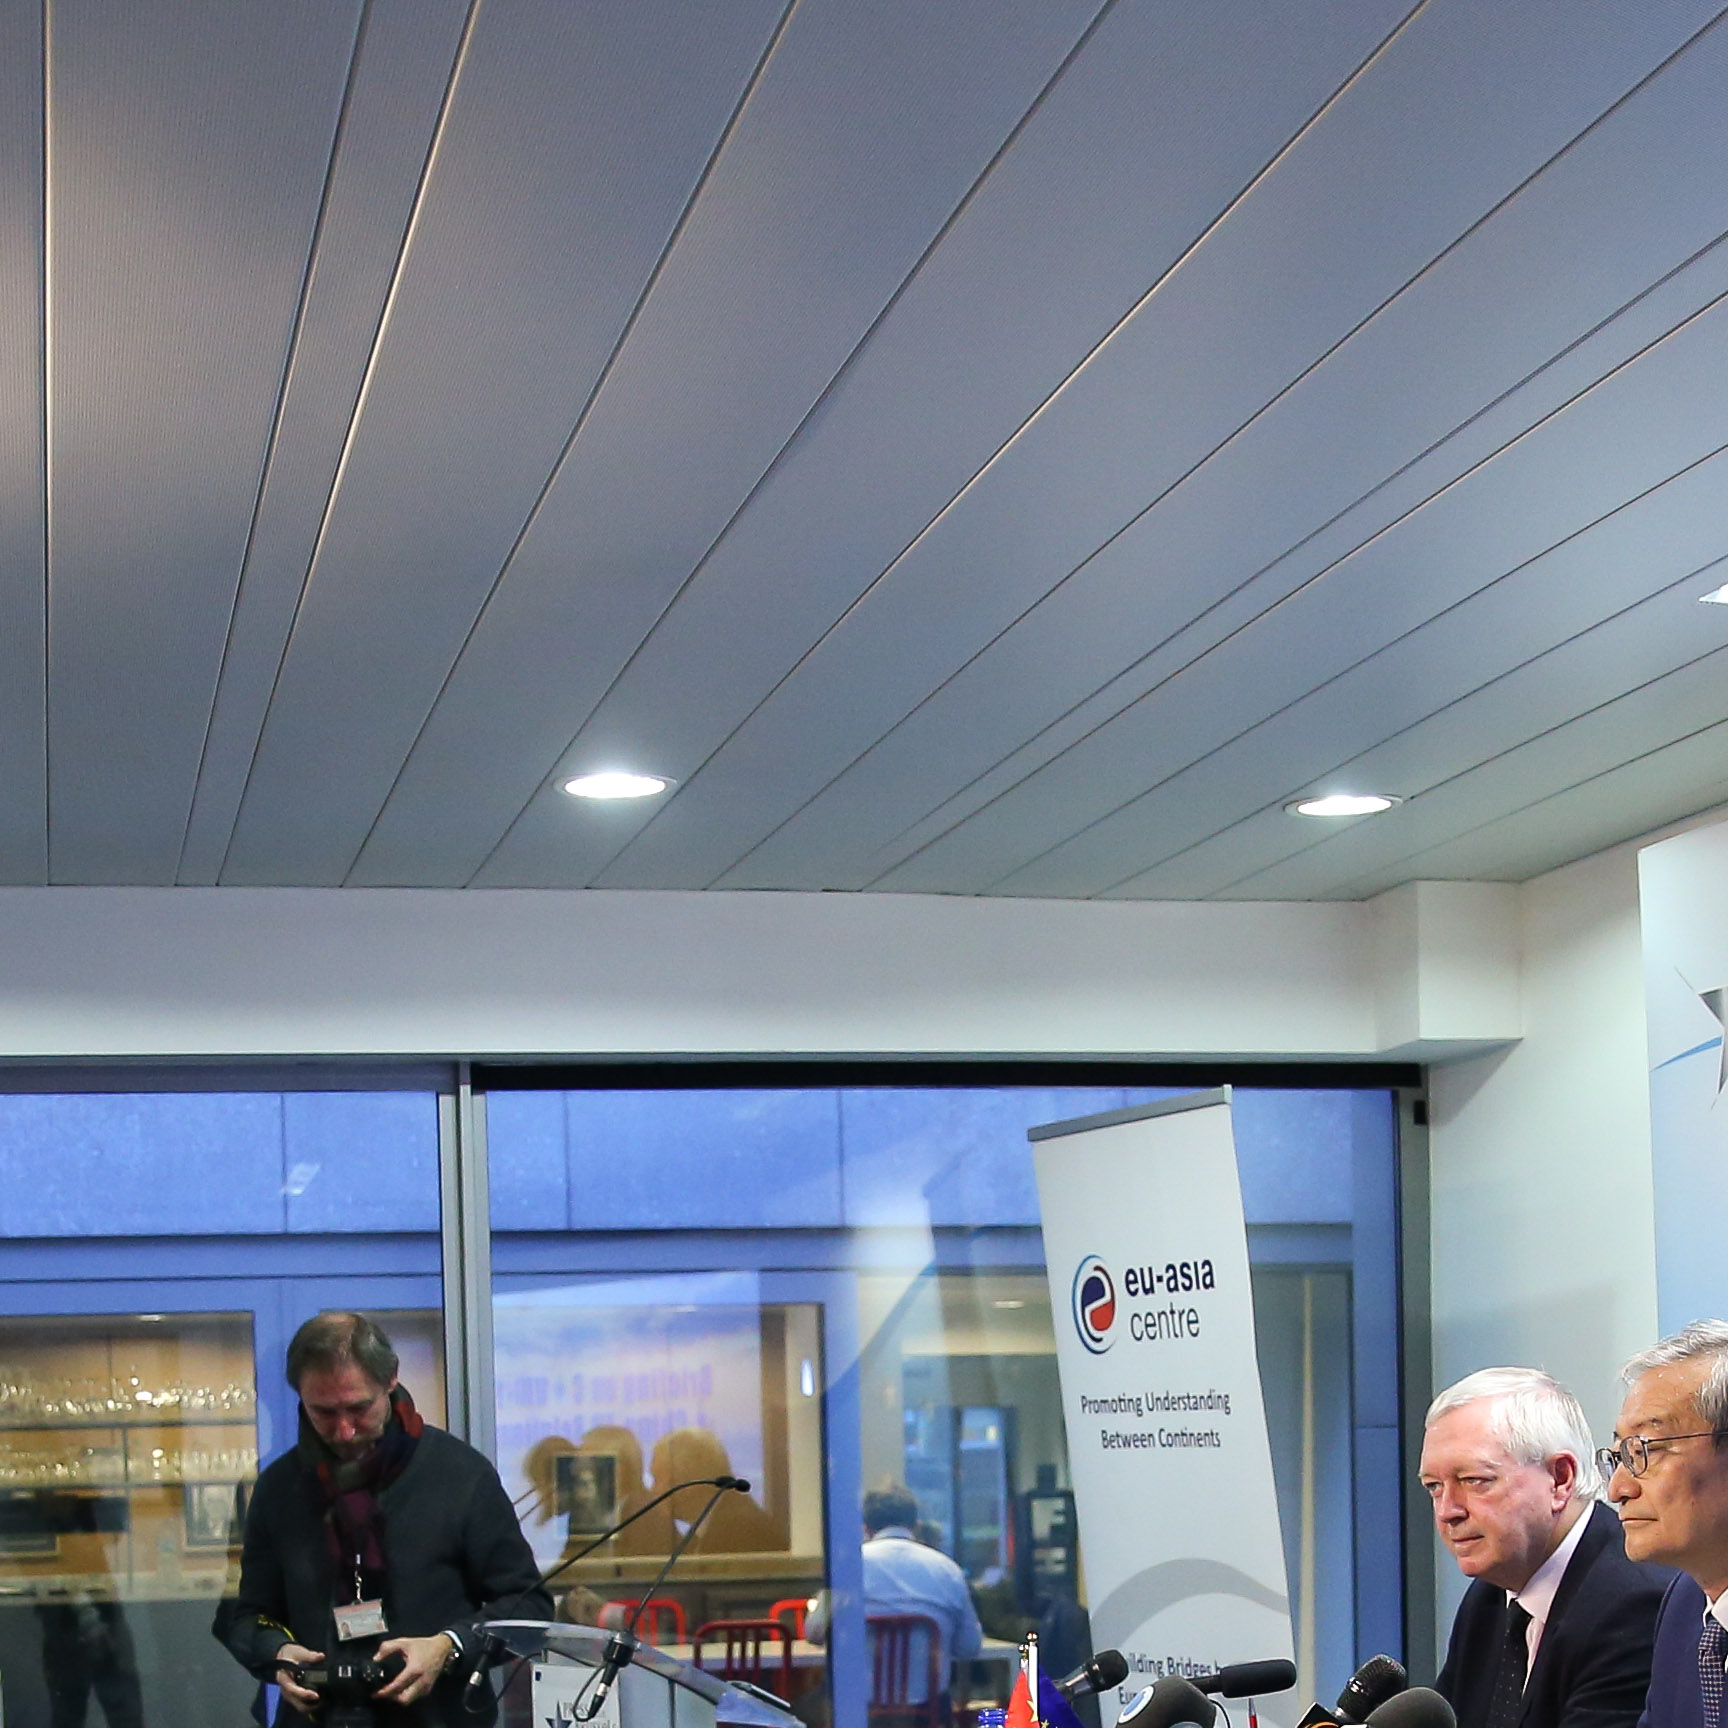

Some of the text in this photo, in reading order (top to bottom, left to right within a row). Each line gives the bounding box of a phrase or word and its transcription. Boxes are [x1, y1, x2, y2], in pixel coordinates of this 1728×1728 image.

[1124, 1258, 1216, 1298] eu-asia
[1130, 1301, 1200, 1341] centre
[1080, 1389, 1232, 1418] Promoting Understanding
[1101, 1427, 1222, 1450] Between Continents
[1128, 1652, 1165, 1679] ilding
